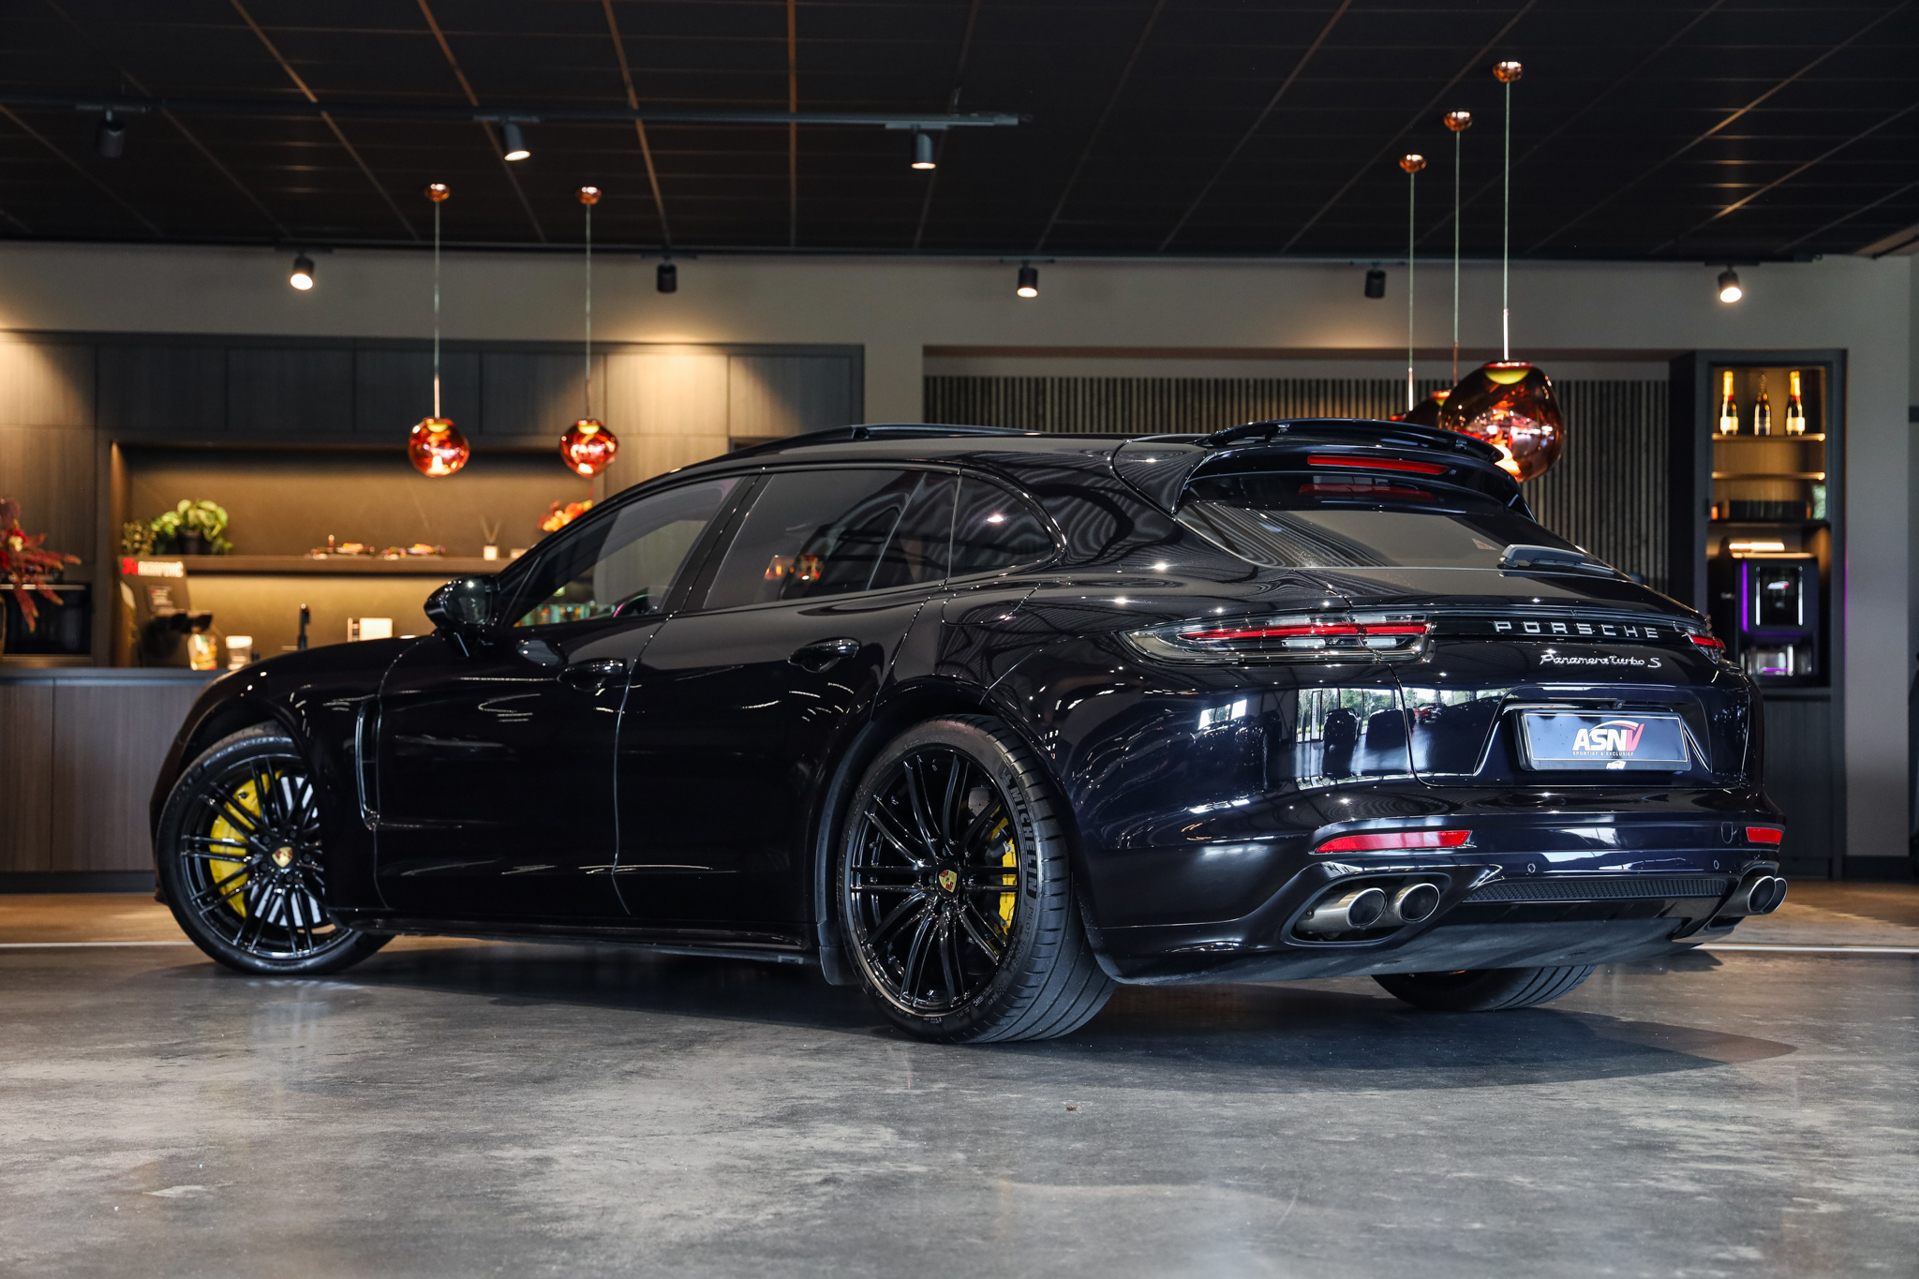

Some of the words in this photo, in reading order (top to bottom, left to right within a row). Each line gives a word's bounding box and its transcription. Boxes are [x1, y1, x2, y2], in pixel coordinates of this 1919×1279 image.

[1494, 620, 1659, 639] PORSCHE
[1539, 653, 1609, 666] Panamera
[1609, 655, 1645, 666] Turbo
[1647, 657, 1662, 669] S
[1572, 721, 1645, 752] ASNV
[1009, 786, 1037, 892] MICHELIN
[1023, 906, 1035, 937] PILOT
